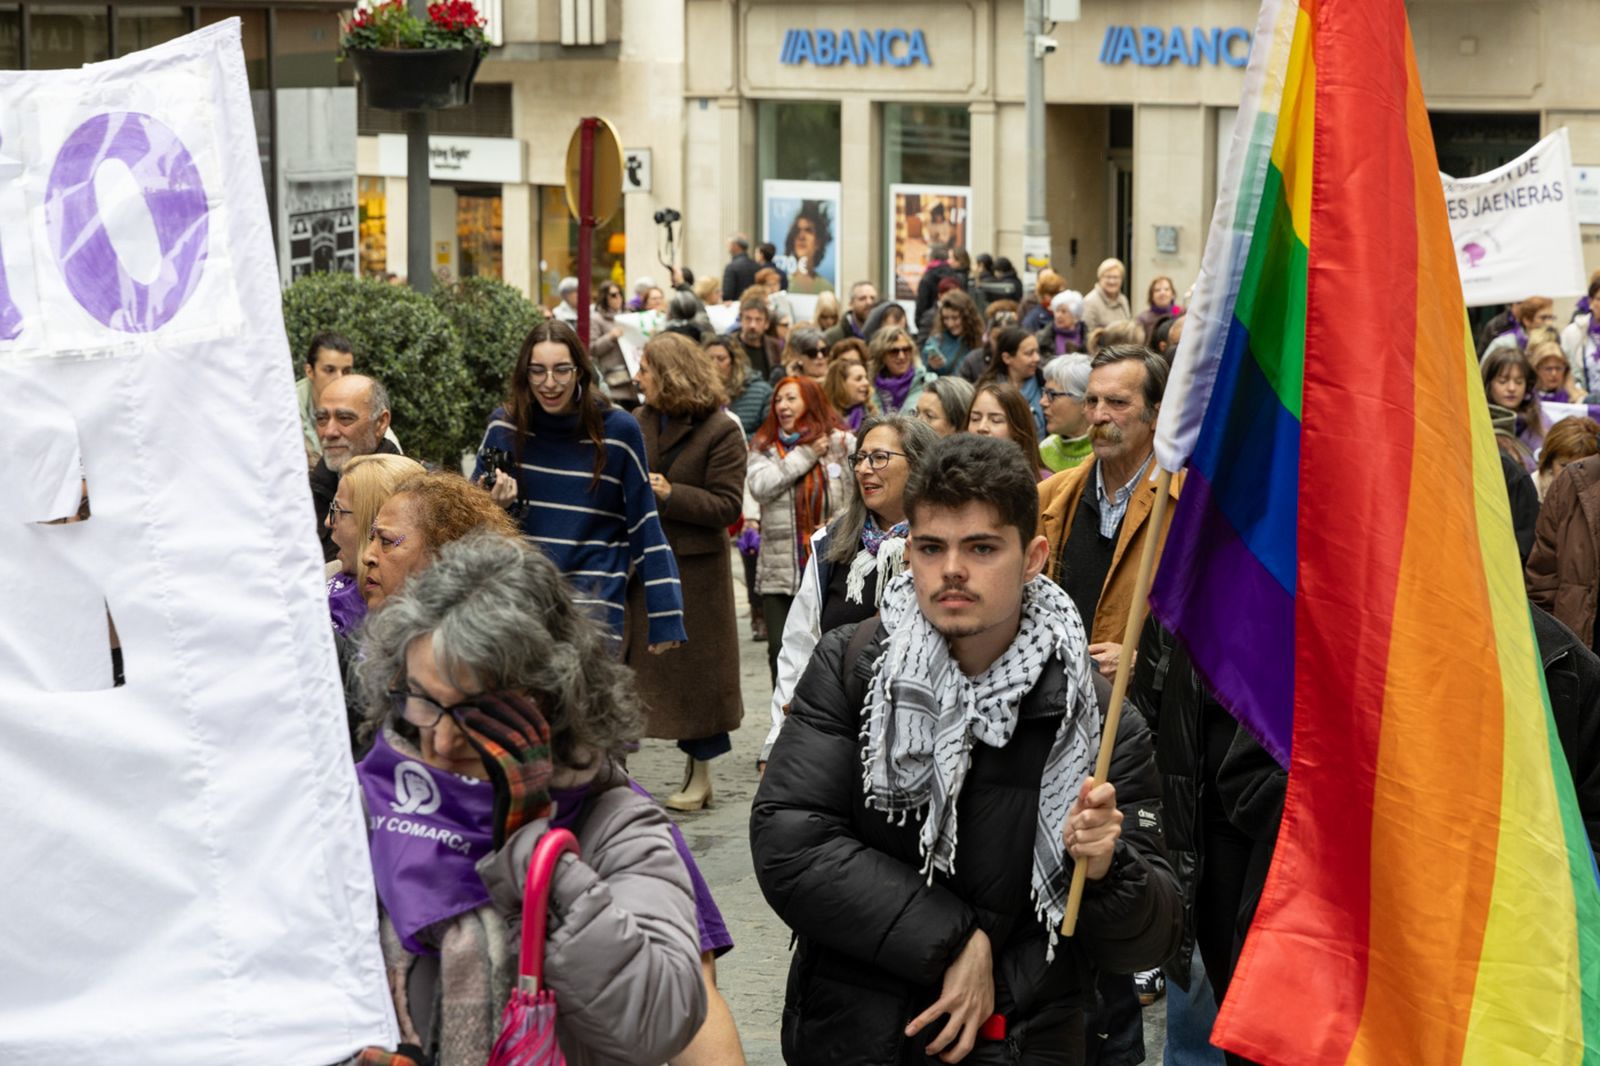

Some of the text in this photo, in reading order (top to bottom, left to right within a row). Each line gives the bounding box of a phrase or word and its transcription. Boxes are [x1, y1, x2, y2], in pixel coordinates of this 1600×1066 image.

[780, 28, 931, 66] ABANCA
[1099, 25, 1253, 67] ABANC
[1448, 199, 1469, 220] ES
[1473, 181, 1564, 217] JAENERAS
[386, 817, 472, 854] COMARCA
